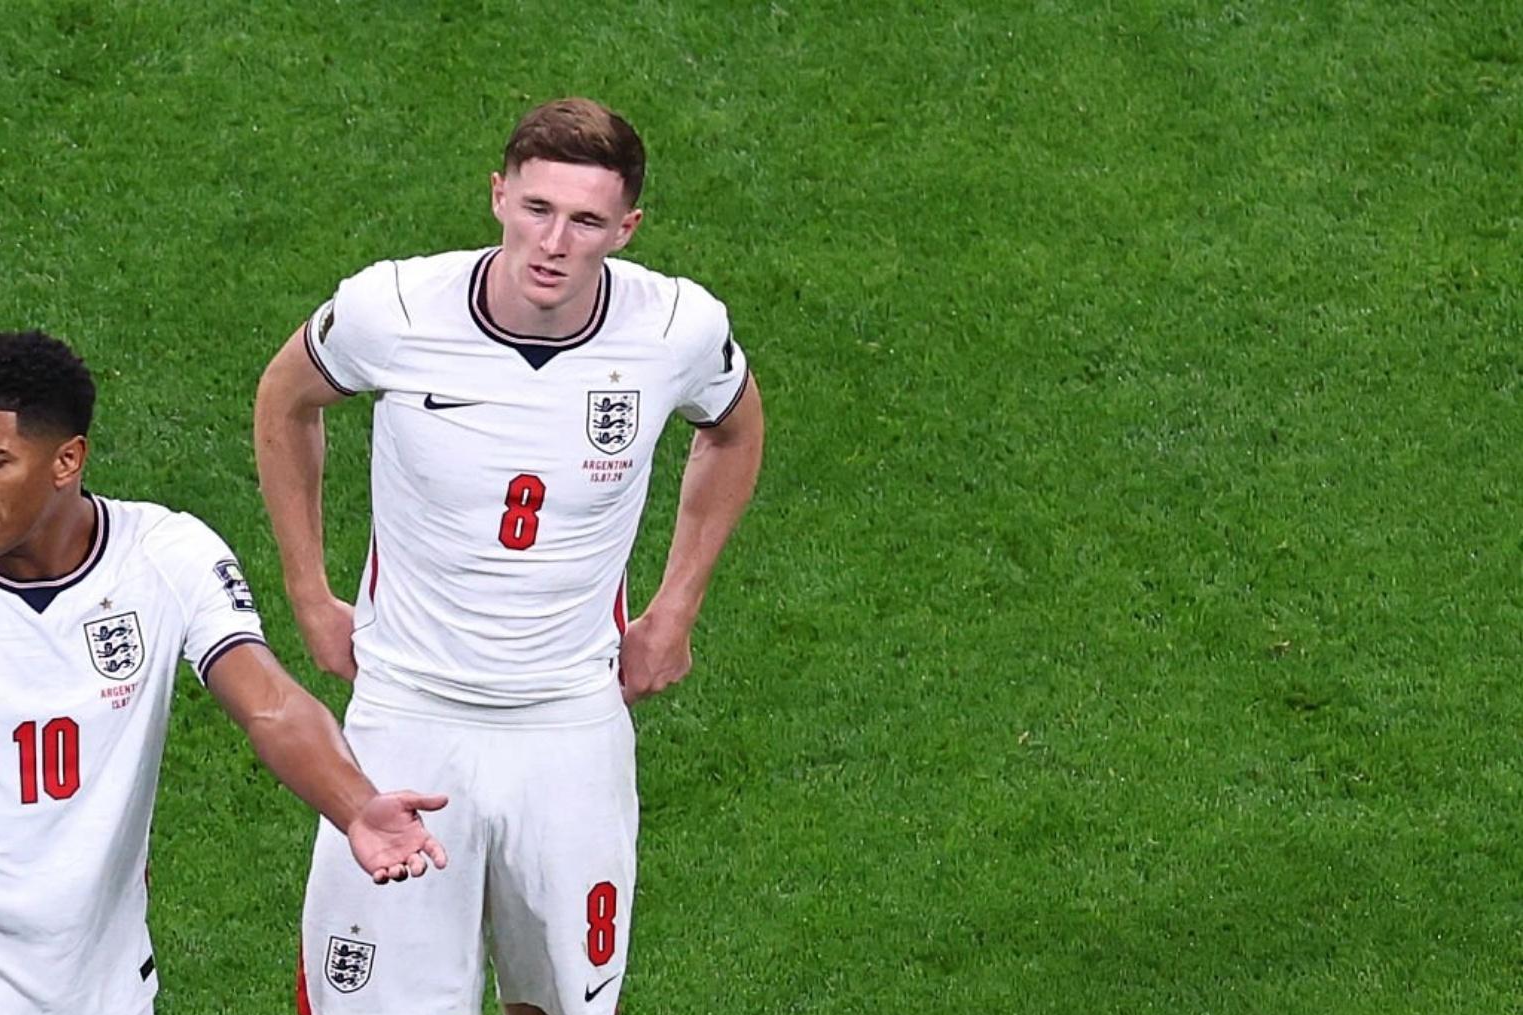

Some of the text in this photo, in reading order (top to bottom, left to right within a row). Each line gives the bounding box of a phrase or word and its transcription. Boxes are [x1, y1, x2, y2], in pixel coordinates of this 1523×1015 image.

[582, 459, 633, 470] ARGENTINA
[498, 474, 546, 551] 8
[101, 682, 138, 698] ARGENT
[12, 716, 81, 805] 10
[587, 881, 617, 967] 8
